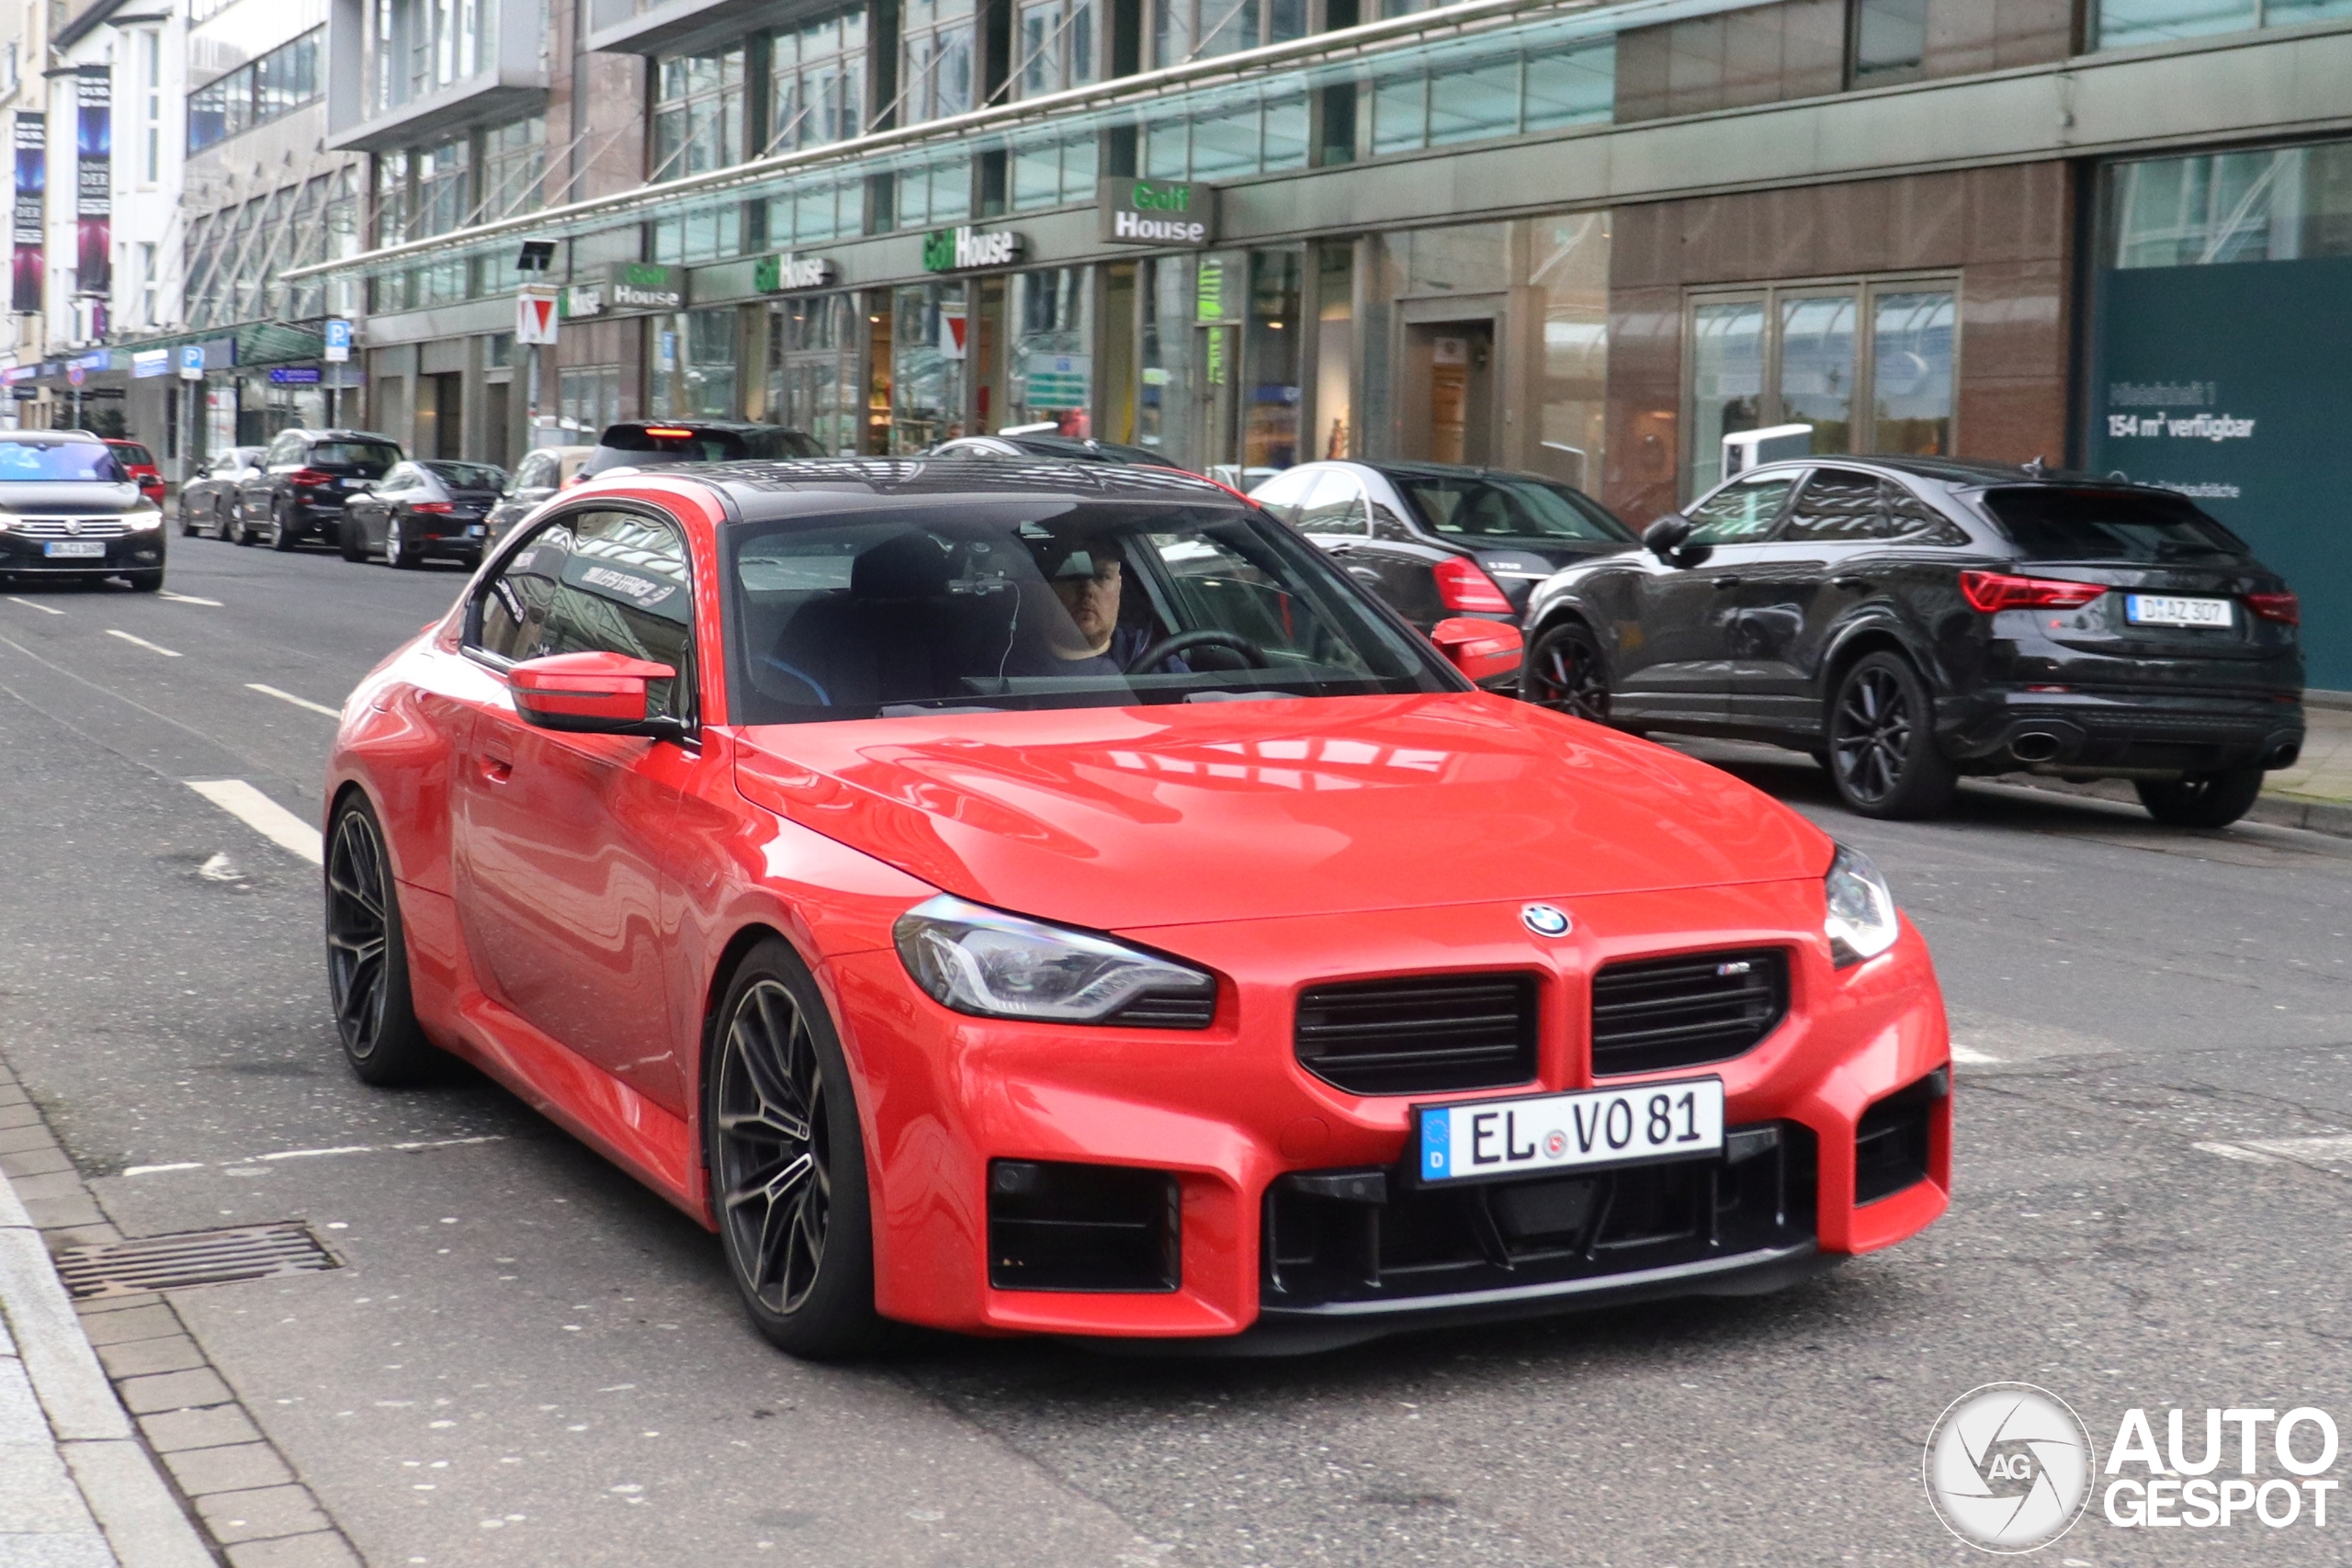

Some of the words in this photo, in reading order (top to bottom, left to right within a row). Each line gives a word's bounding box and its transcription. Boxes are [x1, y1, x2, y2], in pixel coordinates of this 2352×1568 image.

[1133, 183, 1190, 212] Golf
[1115, 210, 1204, 242] House
[615, 285, 679, 306] House
[2108, 415, 2138, 436] 154
[2166, 413, 2256, 442] verfügbar
[2144, 599, 2155, 618] D
[2168, 601, 2188, 620] AZ
[2192, 602, 2221, 621] 307
[1430, 1152, 1443, 1168] D
[1472, 1111, 1535, 1166] EL
[1574, 1098, 1632, 1154] VO
[1646, 1091, 1701, 1145] 81
